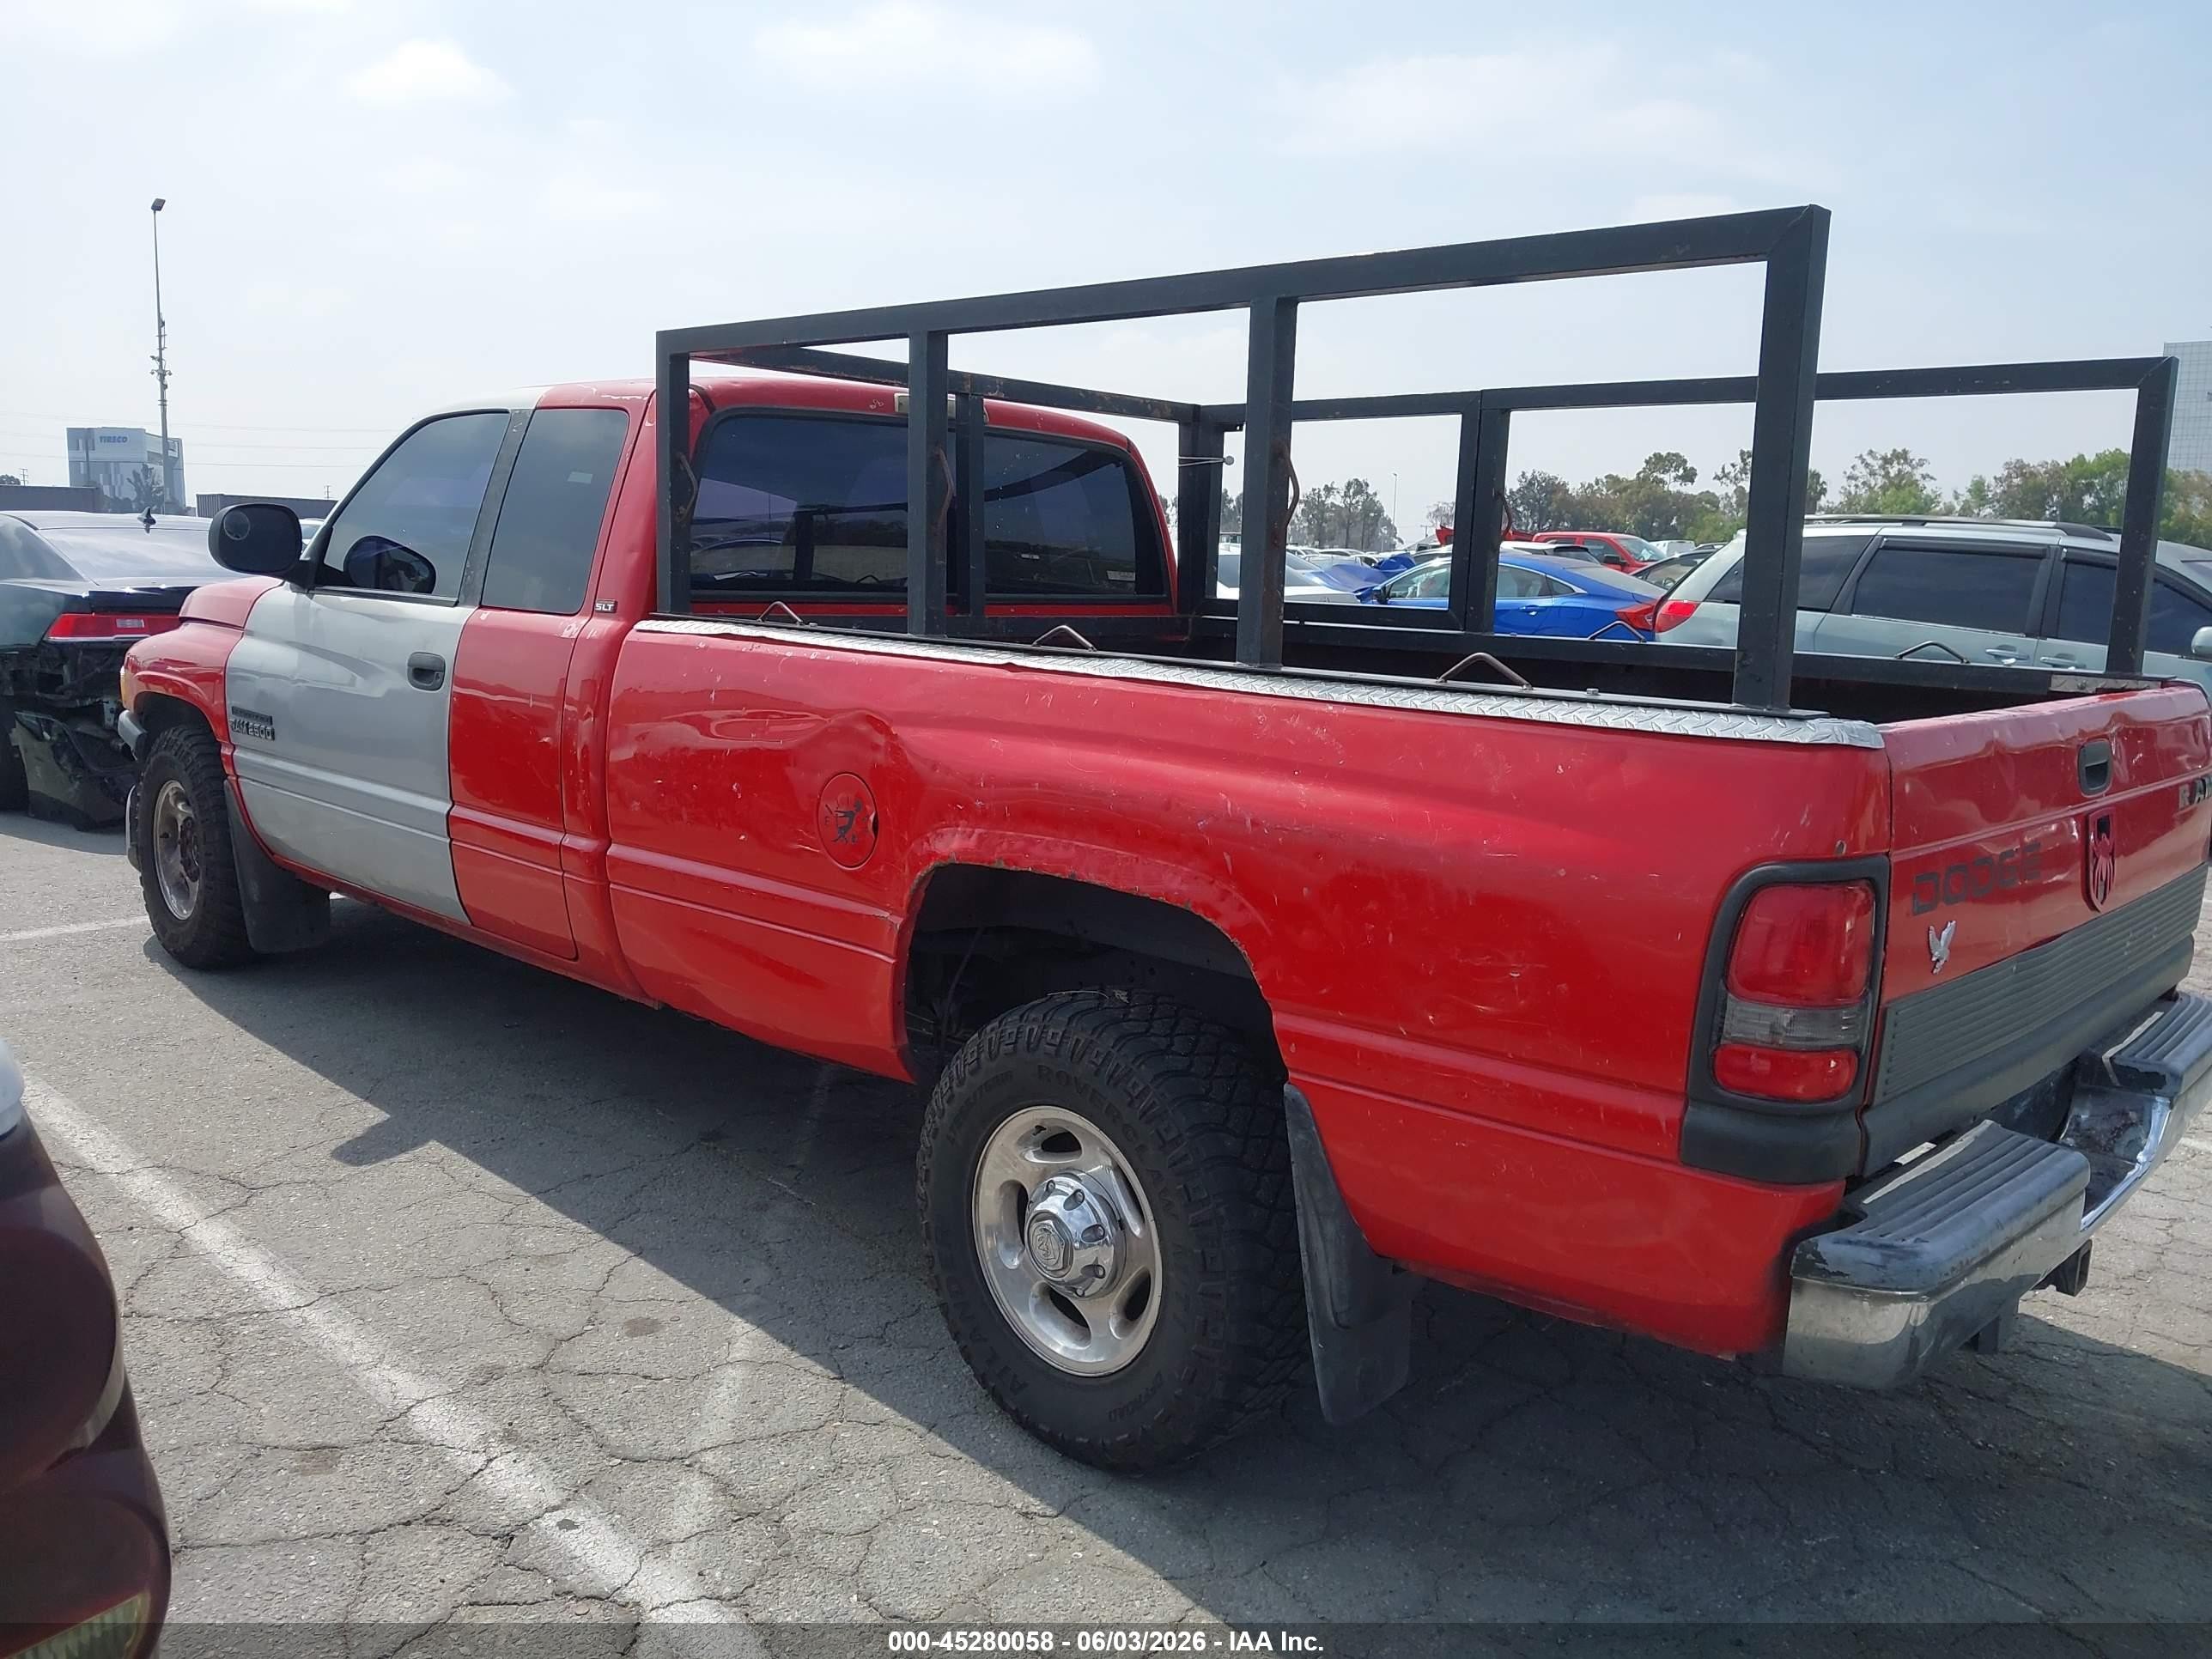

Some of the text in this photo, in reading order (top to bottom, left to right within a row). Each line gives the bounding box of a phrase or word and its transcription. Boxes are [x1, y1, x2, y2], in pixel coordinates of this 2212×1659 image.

[595, 603, 615, 611] SLT
[247, 722, 275, 741] 2500
[1912, 842, 2041, 916] DODGE
